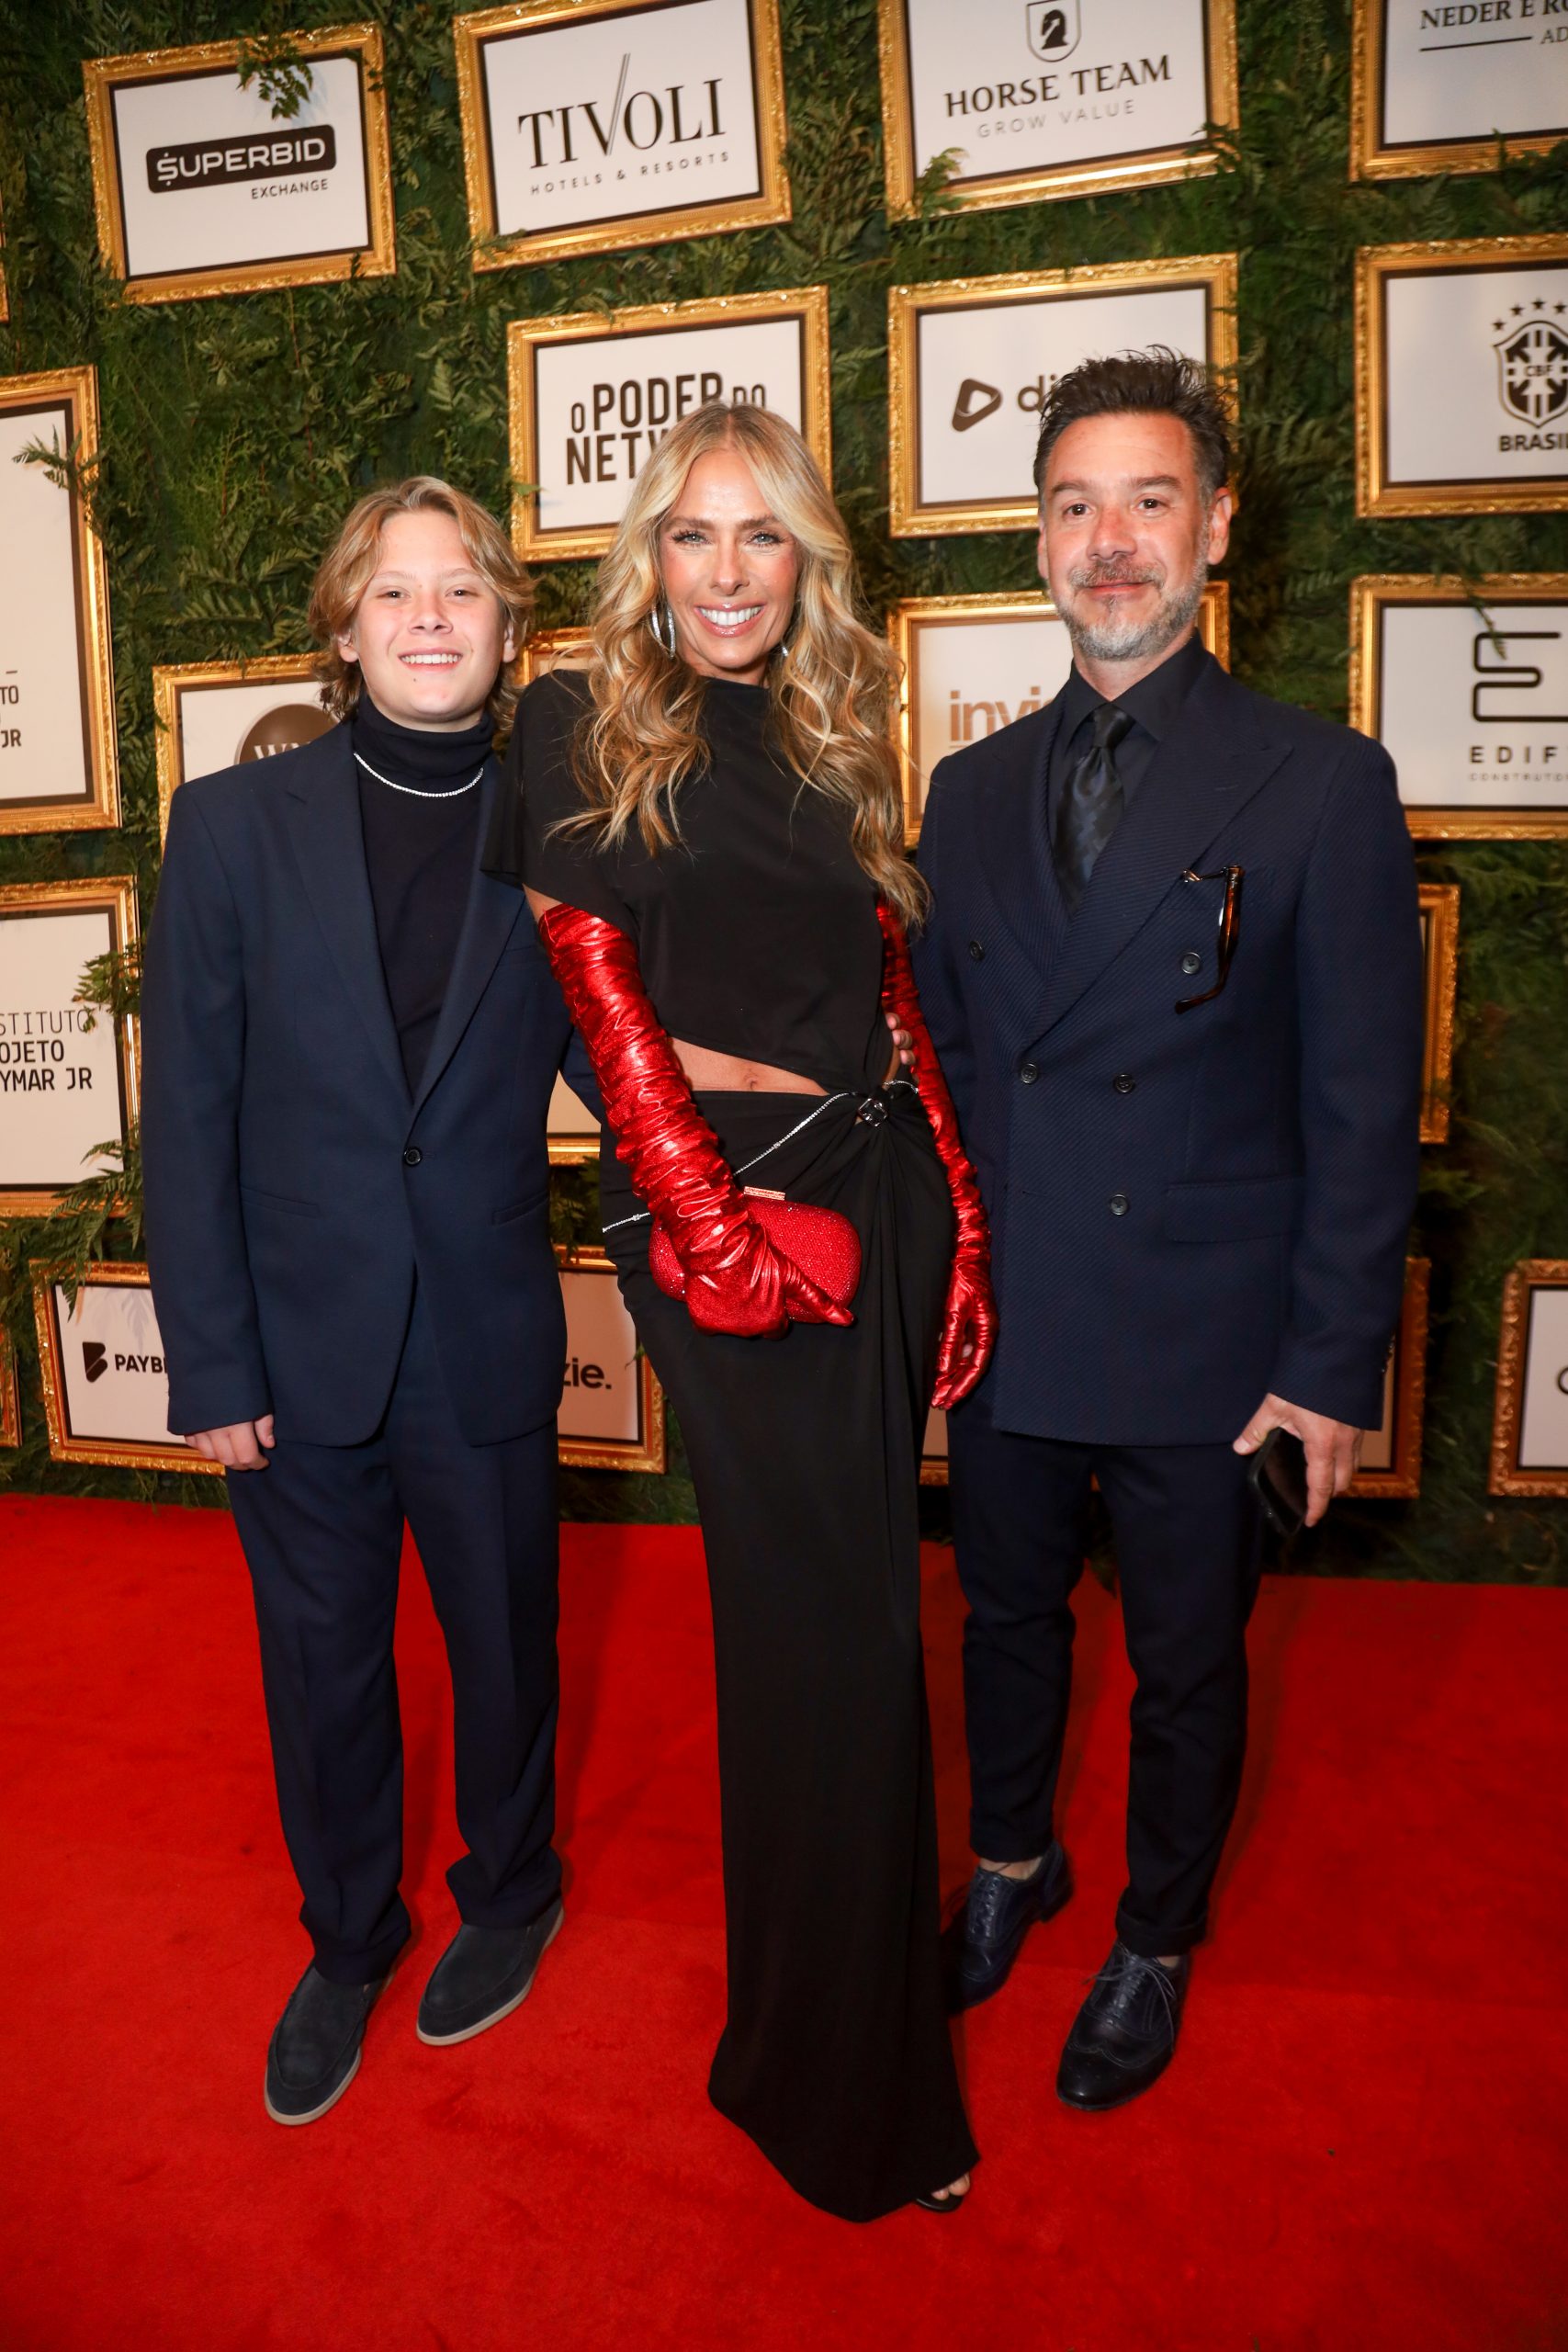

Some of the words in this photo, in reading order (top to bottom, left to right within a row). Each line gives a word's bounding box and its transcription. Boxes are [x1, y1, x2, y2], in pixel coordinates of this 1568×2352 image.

[1420, 2, 1512, 29] NEDER
[1520, 0, 1535, 17] E
[943, 75, 1060, 118] HORSE
[1071, 54, 1172, 96] TEAM
[517, 52, 727, 170] TIVOLI
[978, 114, 1047, 138] GROW
[1059, 99, 1135, 124] VALUE
[156, 138, 326, 187] SUPERBID
[530, 174, 603, 196] HOTELS
[615, 169, 626, 181] &
[640, 151, 730, 176] RESORTS
[251, 178, 329, 200] EXCHANGE
[571, 402, 585, 434] O
[593, 371, 723, 432] PODER
[1499, 433, 1568, 452] BRASI
[0, 729, 22, 748] JR
[65, 1067, 93, 1091] JR
[115, 1354, 167, 1374] PAYB
